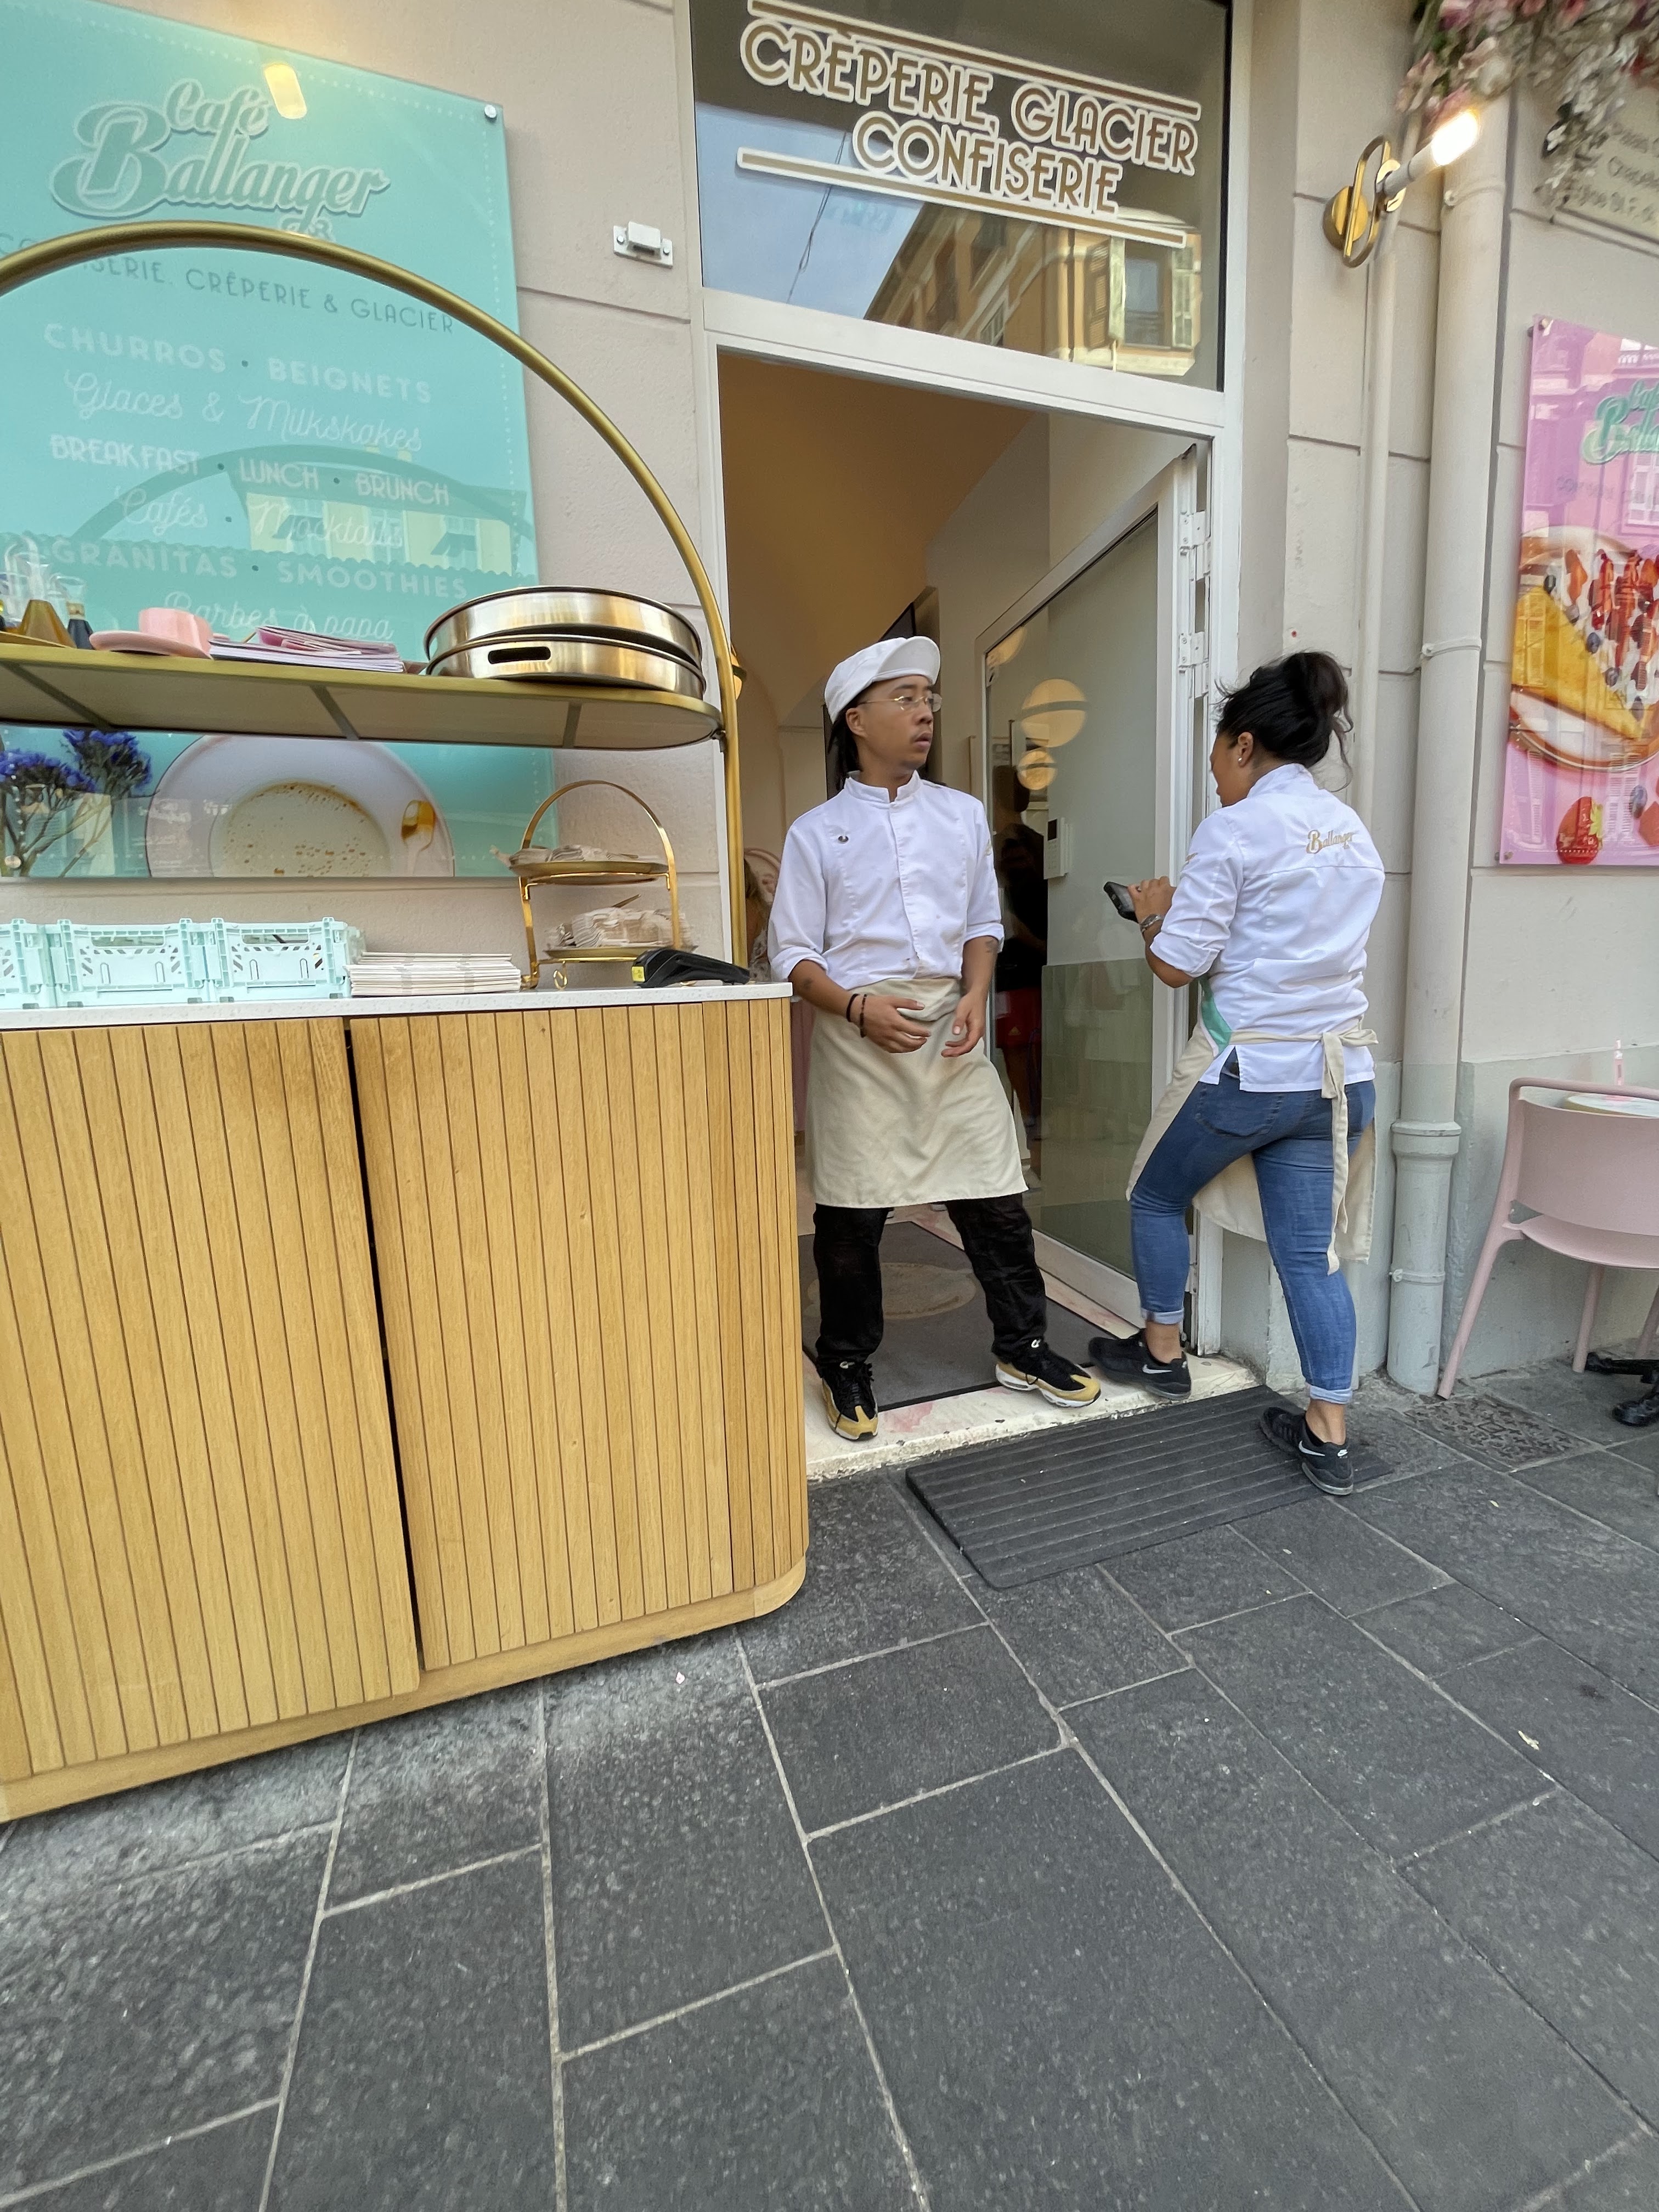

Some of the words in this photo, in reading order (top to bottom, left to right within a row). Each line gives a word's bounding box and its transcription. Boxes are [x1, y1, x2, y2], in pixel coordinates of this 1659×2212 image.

[166, 78, 272, 136] Café
[1012, 82, 1198, 176] GLACIER
[49, 100, 391, 226] Ballanger
[853, 111, 1123, 218] CONFISERIE
[185, 268, 311, 309] CRÊPERIE
[324, 293, 338, 313] &
[351, 298, 454, 334] GLACIER
[44, 323, 226, 374] CHURROS
[267, 357, 431, 404] BEIGNETS
[64, 369, 183, 420] Glaces
[201, 391, 224, 422] &
[50, 433, 200, 476] BREAKFAST
[239, 456, 319, 491] LUNCH
[356, 472, 450, 506] BRUNCH
[114, 486, 208, 537] Cafés
[52, 537, 238, 578] GRANITAS
[276, 561, 467, 599] SMOOTHIES
